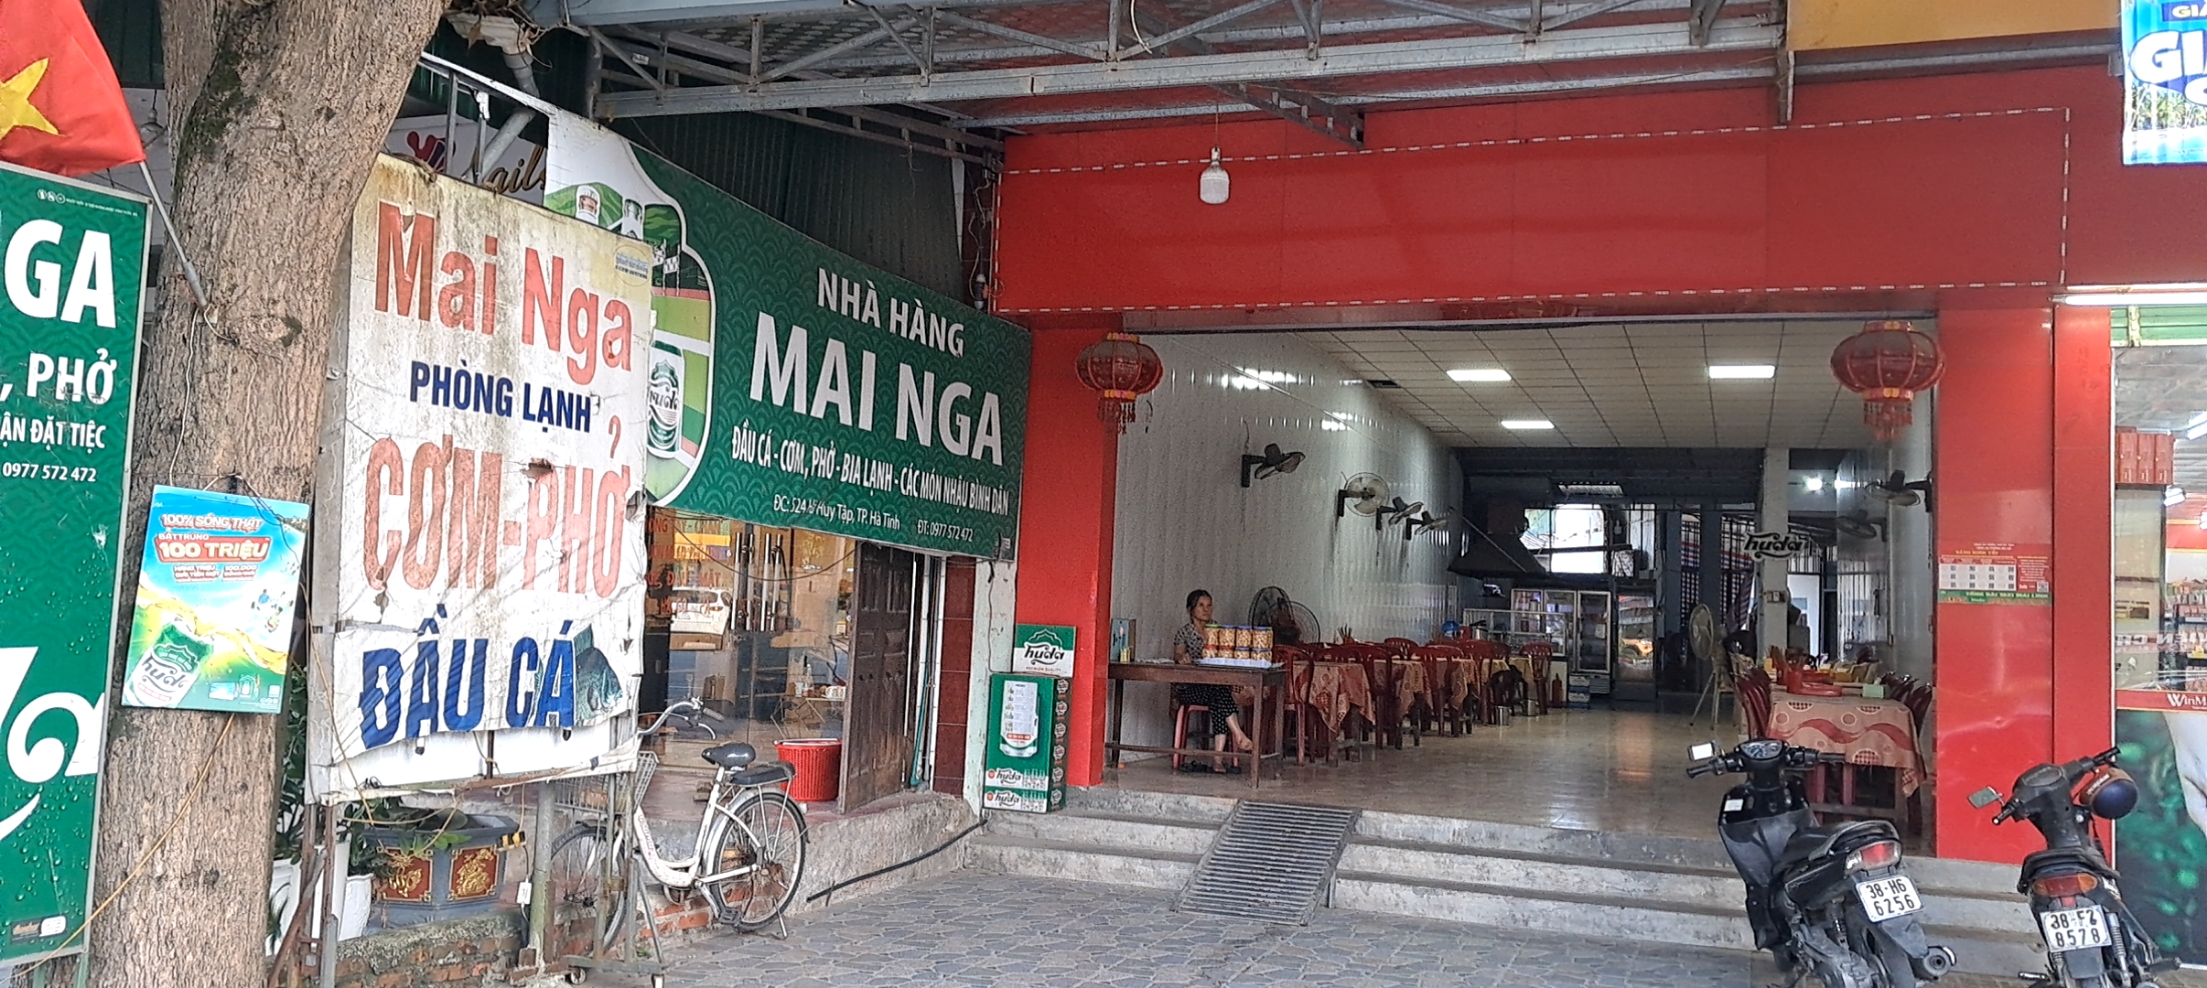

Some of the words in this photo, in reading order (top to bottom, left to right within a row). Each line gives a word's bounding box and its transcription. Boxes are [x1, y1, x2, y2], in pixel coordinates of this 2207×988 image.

[4, 218, 117, 329] GA
[374, 200, 498, 336] Mai
[521, 246, 633, 385] Nga
[817, 266, 881, 328] NHÀ
[889, 297, 965, 358] HÀNG
[27, 347, 118, 405] PHỞ
[410, 359, 513, 418] PHÒNG
[522, 382, 592, 433] LẠNH
[750, 310, 877, 432] MAI
[895, 361, 1004, 466] NGA
[0, 411, 26, 448] ẬN
[30, 415, 65, 451] ĐẶT
[69, 419, 107, 454] TIỆC
[2, 461, 39, 479] 0977
[41, 464, 69, 481] 572
[70, 466, 97, 482] 472
[732, 417, 757, 464] ĐẦU
[757, 428, 773, 468] CÁ
[810, 440, 837, 480] PHỞ
[840, 452, 861, 485] BIA
[862, 457, 894, 497] LẠNH
[900, 462, 920, 497] CÁC
[919, 467, 943, 503] MÓN
[942, 474, 969, 514] NHẬU
[158, 541, 202, 558] 100
[203, 539, 269, 561] TRIỆU
[1744, 532, 1804, 559] huda
[358, 603, 489, 751] ĐẦU
[506, 619, 575, 729] CÁ
[1024, 643, 1065, 665] huda
[1873, 894, 1915, 916] 6256
[2054, 927, 2101, 948] 8578
